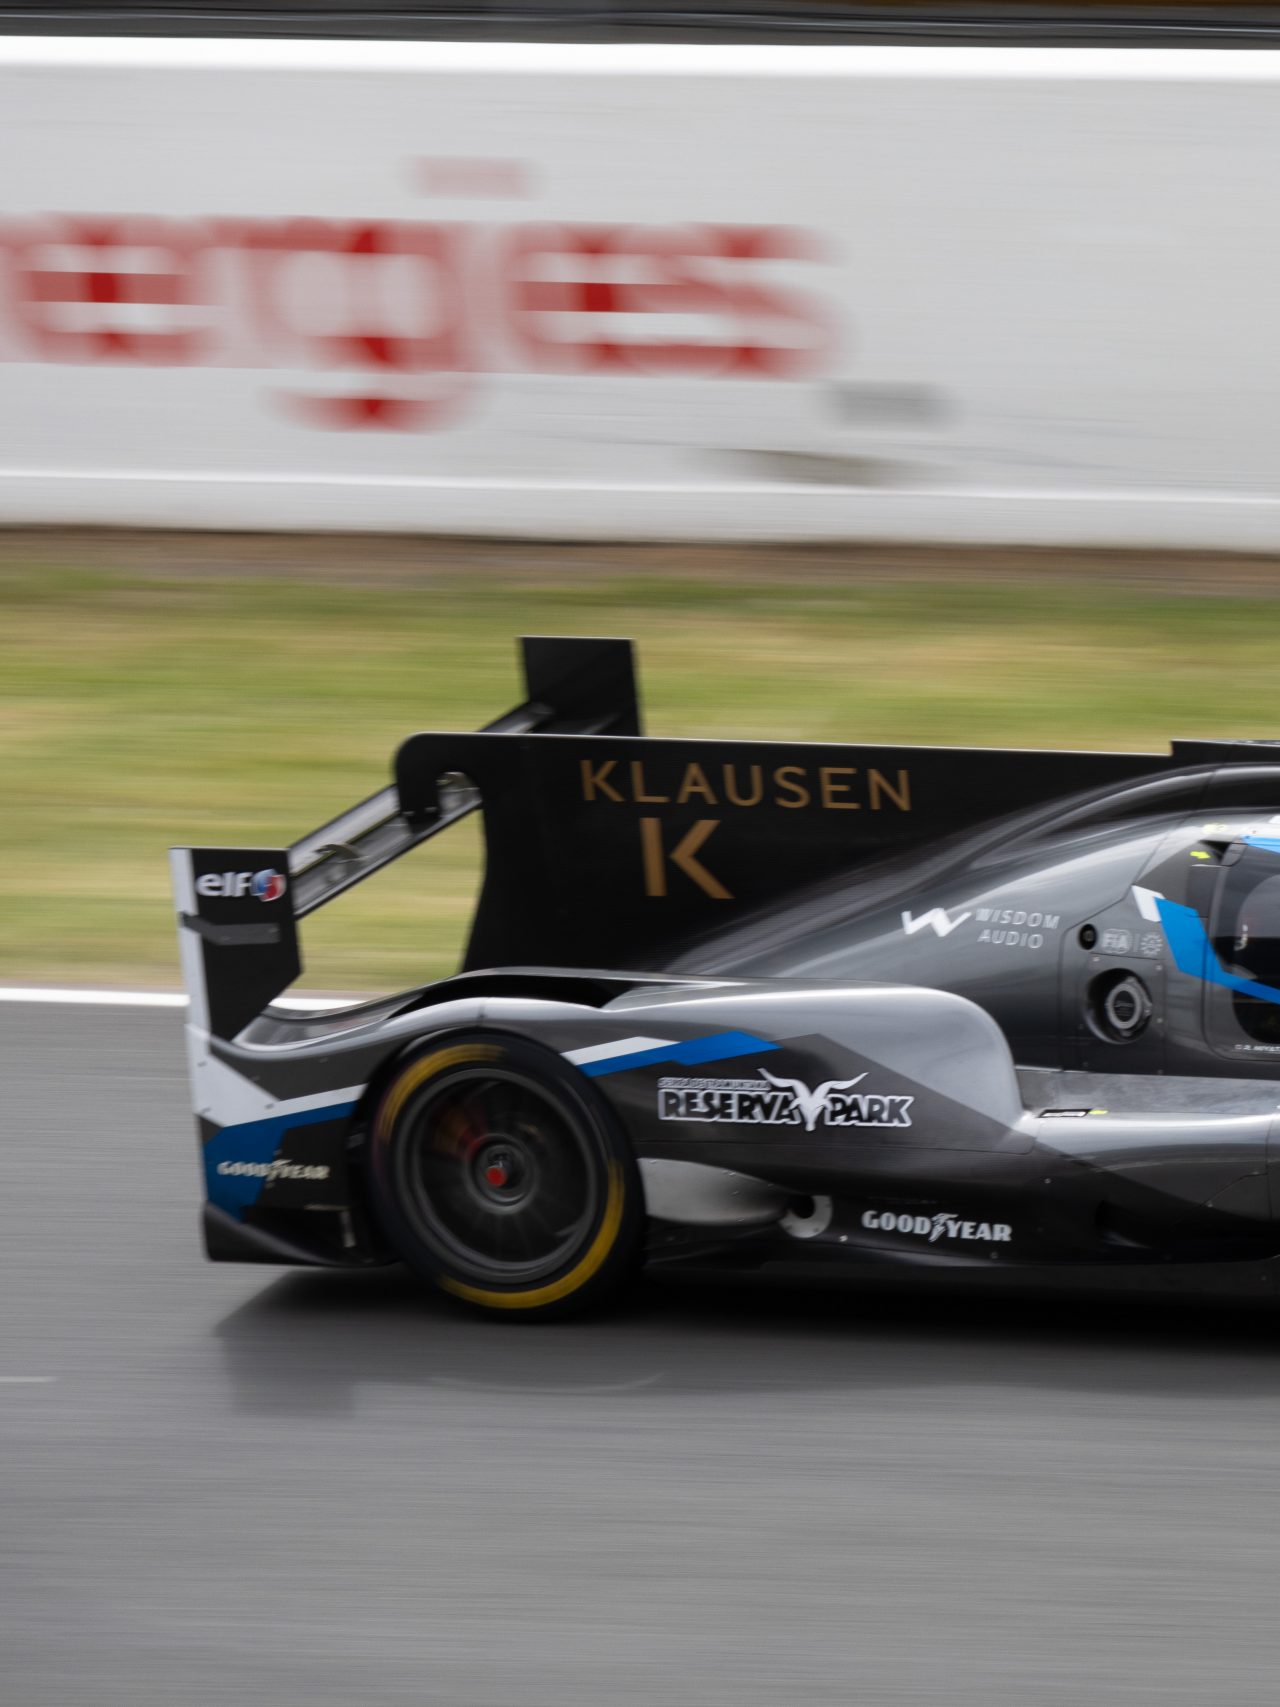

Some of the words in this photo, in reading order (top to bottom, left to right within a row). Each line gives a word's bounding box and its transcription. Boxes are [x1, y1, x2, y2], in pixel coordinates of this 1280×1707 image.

[580, 759, 912, 811] KLAUSEN
[639, 817, 735, 899] K
[196, 871, 254, 897] elf
[975, 908, 1061, 929] WISDOM
[976, 929, 1045, 949] AUDIO
[658, 1088, 801, 1125] RESERVA
[825, 1094, 915, 1128] PARK
[861, 1210, 1013, 1242] GOODYEAR
